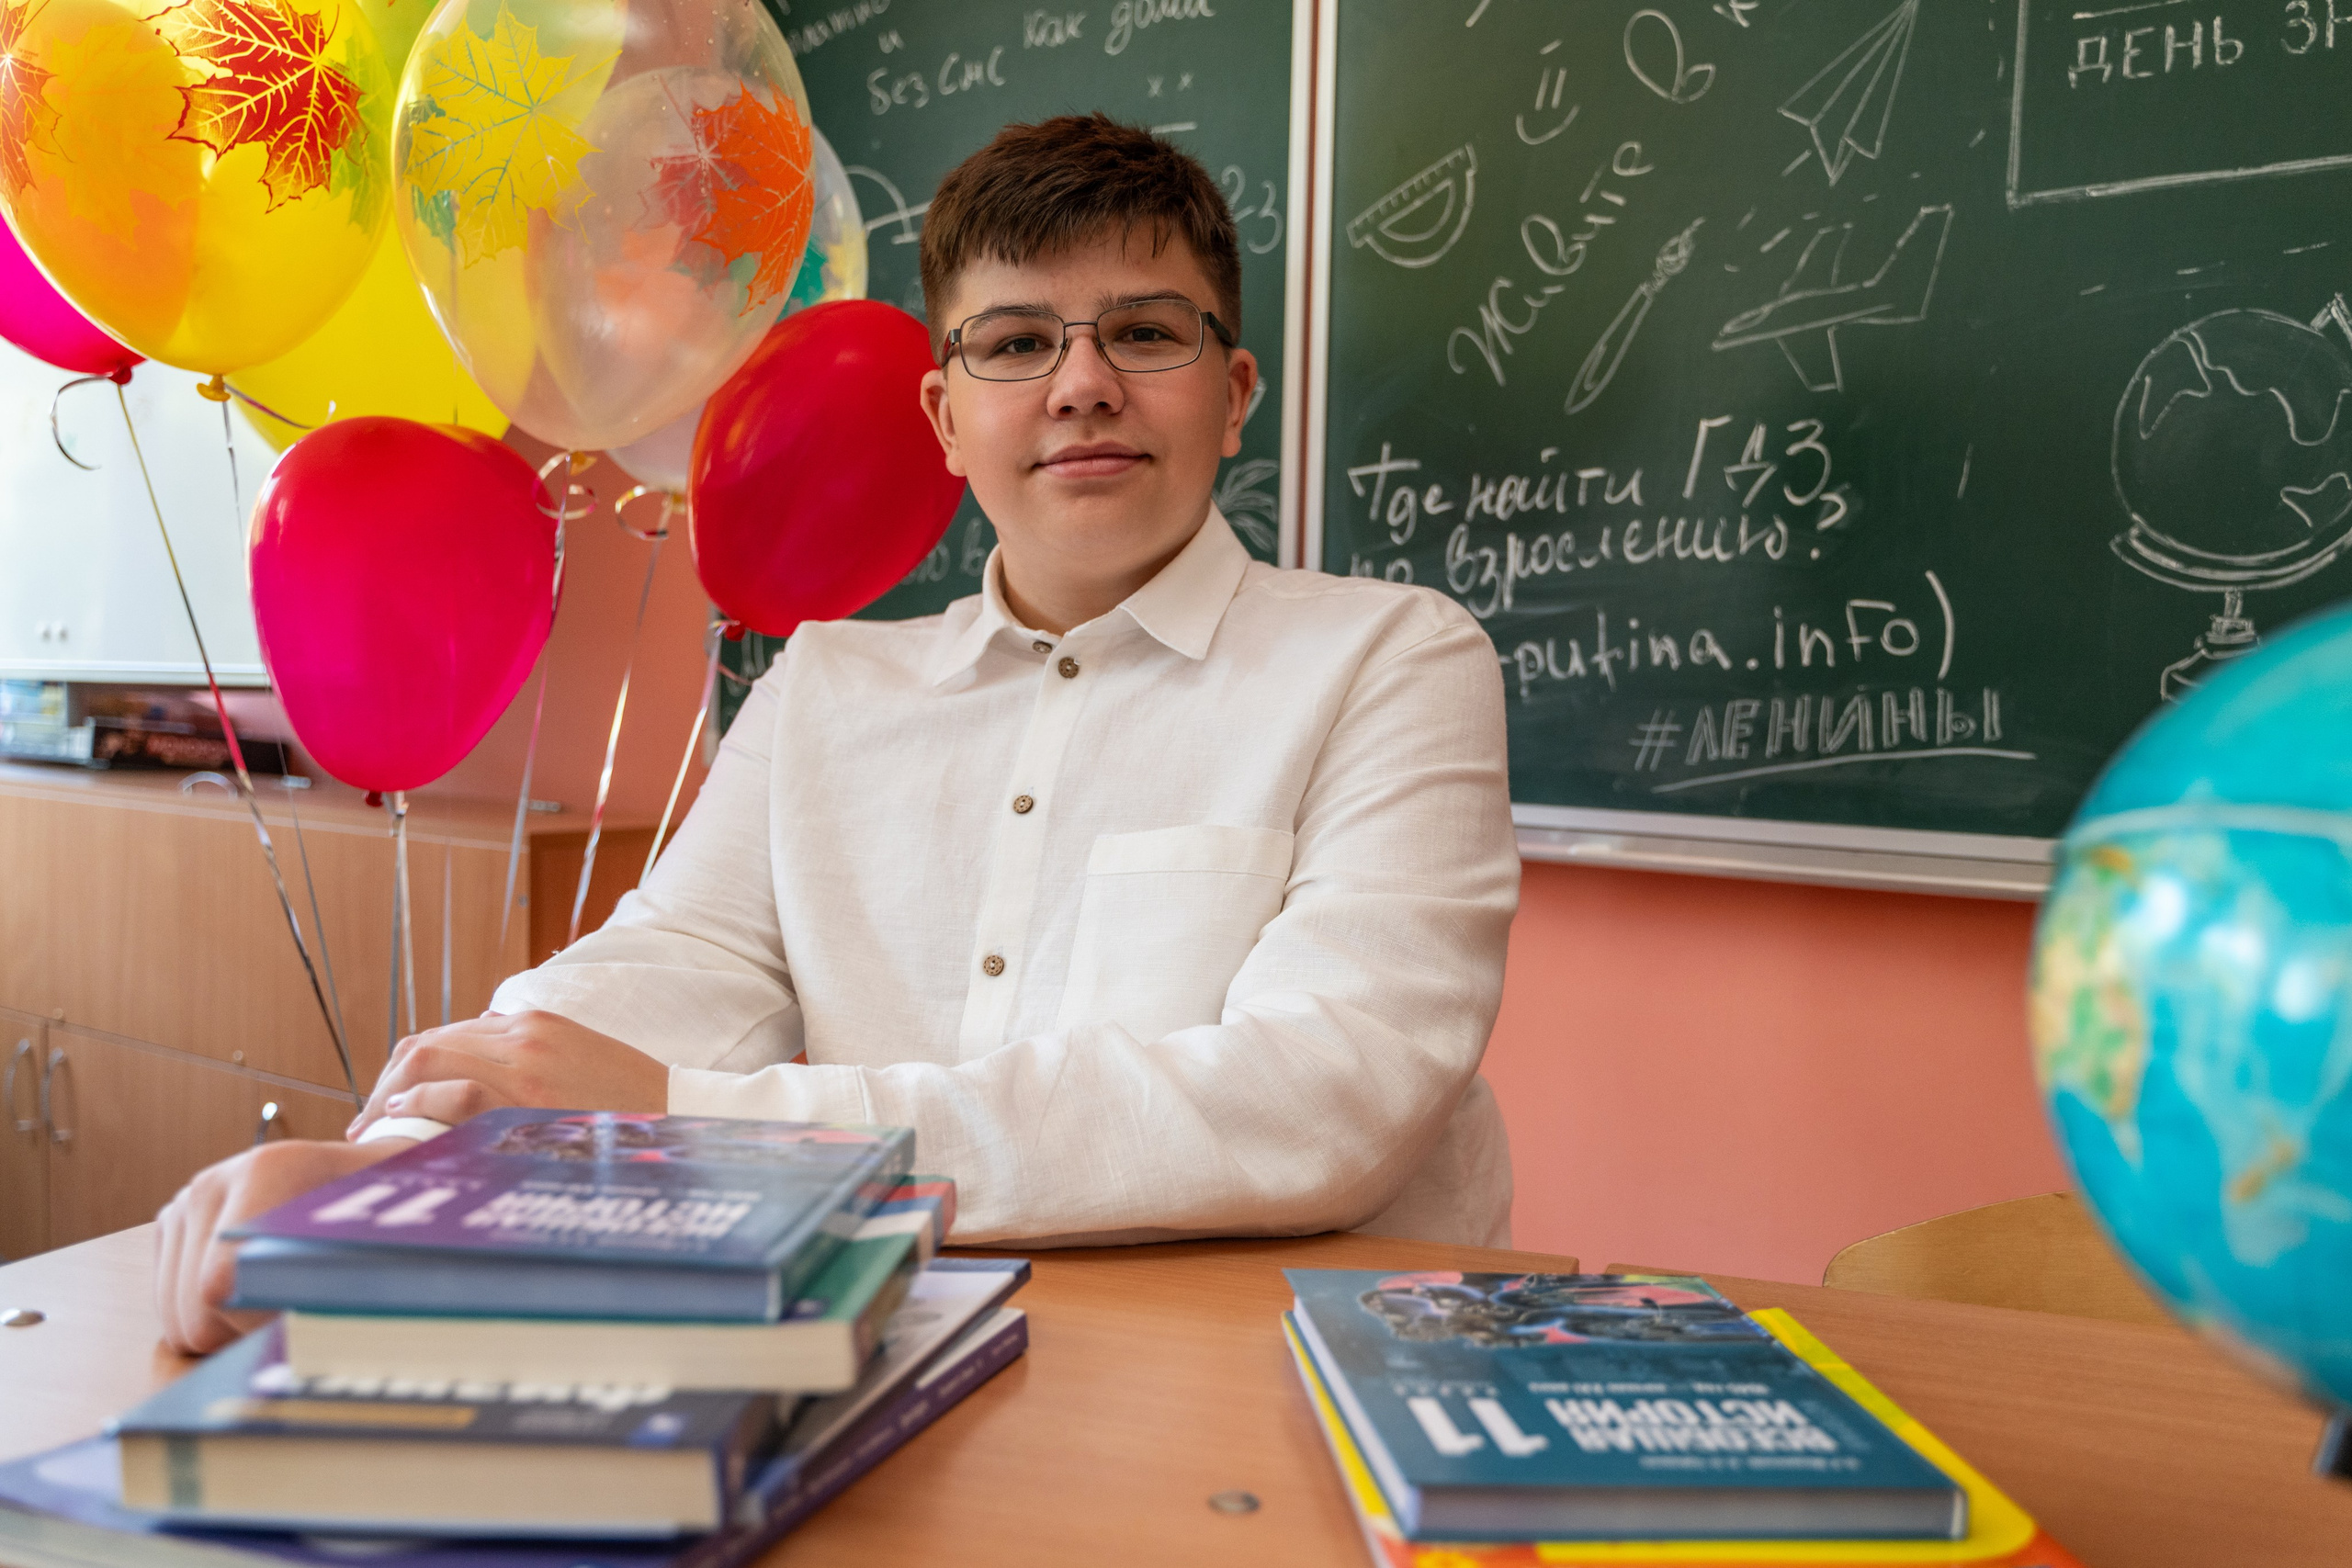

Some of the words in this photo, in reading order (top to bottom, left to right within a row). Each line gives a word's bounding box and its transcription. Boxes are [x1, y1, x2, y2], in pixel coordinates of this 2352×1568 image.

[2067, 15, 2245, 88] ДЕНЬ
[866, 67, 931, 116] без
[1447, 141, 1656, 386] Живите
[1346, 441, 1454, 546] Где
[1464, 446, 1645, 522] найти
[1406, 1397, 1550, 1458] 11
[1544, 1398, 1809, 1427] ИСТОРИЯ
